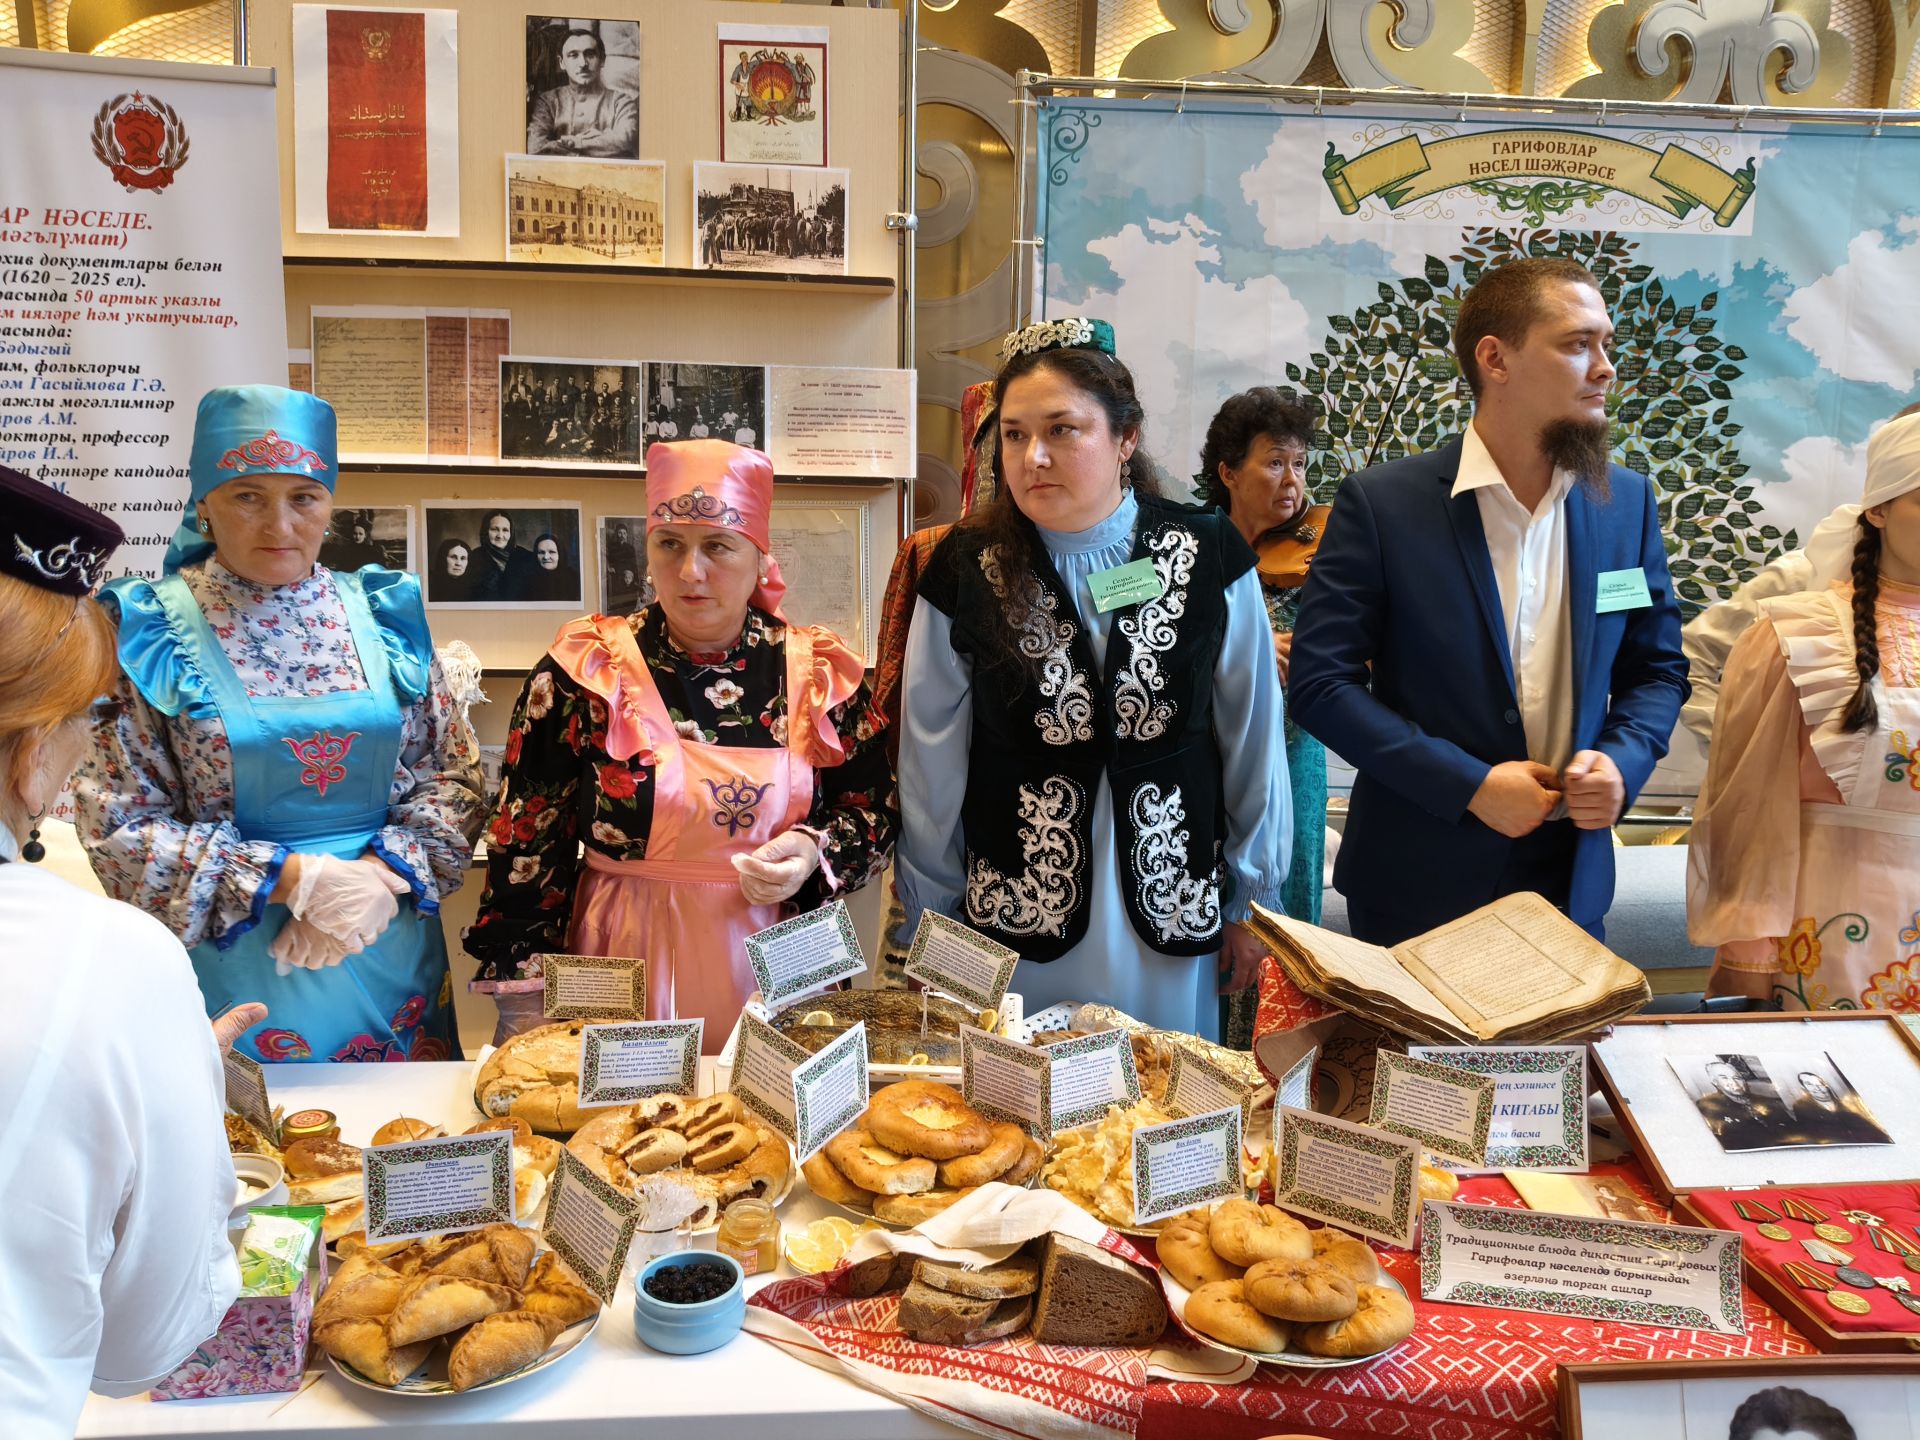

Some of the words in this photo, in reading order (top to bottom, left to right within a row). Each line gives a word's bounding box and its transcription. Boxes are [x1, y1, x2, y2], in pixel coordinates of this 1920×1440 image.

[1492, 140, 1597, 158] ГАРИФОВЛАР
[1469, 158, 1521, 175] НӘСЕЛ
[1524, 158, 1616, 181] ШӘҖӘРӘСЕ
[43, 208, 153, 230] НӘСЕЛЕ.
[0, 255, 34, 266] хив
[40, 252, 168, 271] документлары
[174, 257, 222, 272] белән
[2, 269, 50, 286] (1620
[71, 272, 111, 287] 2025
[116, 273, 147, 288] ел).
[74, 289, 94, 303] 50
[98, 293, 158, 307] артык
[161, 295, 222, 308] указлы
[0, 309, 14, 318] м
[21, 308, 81, 323] ияләре
[87, 308, 120, 322] һәм
[127, 312, 239, 328] укытучылар,
[0, 324, 72, 338] асында:
[34, 359, 141, 376] фольклорчы
[30, 376, 126, 392] Гасыймова
[132, 378, 167, 393] Г.Ә.
[0, 396, 54, 408] ажлы
[59, 398, 175, 412] мөгәллимнәр
[0, 414, 32, 428] ров
[38, 411, 77, 425] А.М.
[82, 430, 170, 447] профессор
[43, 446, 79, 460] И.А.
[36, 464, 109, 481] фәннәре
[1514, 1082, 1556, 1090] хәзинәсе
[1500, 1103, 1559, 1116] КИТАБЫ
[1511, 1128, 1541, 1138] басма
[1445, 1233, 1535, 1253] Традиционные
[1538, 1243, 1577, 1258] блюда
[1580, 1247, 1642, 1266] династии
[1645, 1256, 1717, 1273] Гарифовых
[1470, 1251, 1546, 1271] Гарифовлар
[1549, 1262, 1610, 1277] нәселендә
[1613, 1267, 1690, 1285] борынгыдан
[1504, 1271, 1559, 1287] әзерләнә
[1562, 1278, 1607, 1293] торган
[1611, 1283, 1653, 1298] ашлар
